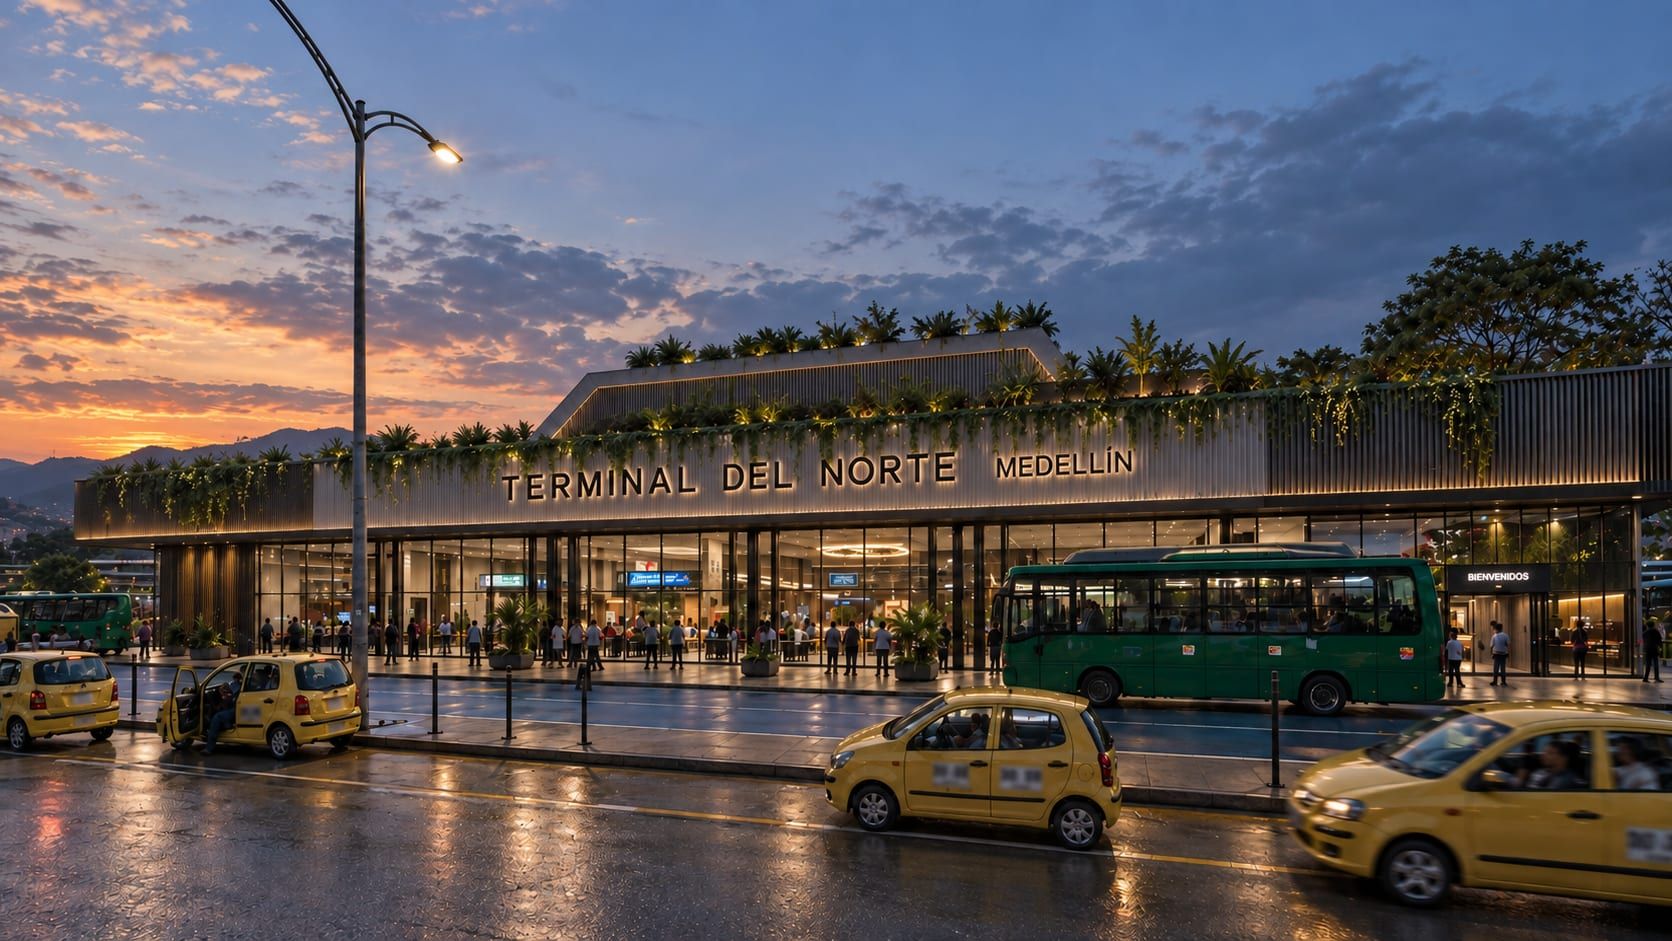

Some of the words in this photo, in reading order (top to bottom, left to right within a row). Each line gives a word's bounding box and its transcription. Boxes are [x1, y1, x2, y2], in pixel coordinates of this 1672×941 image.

[501, 464, 697, 502] TERMINAL
[723, 460, 793, 492] DEL
[821, 451, 956, 487] NORTE
[996, 446, 1133, 479] MEDELLÍN
[1467, 572, 1529, 581] BIENVENIDOS
